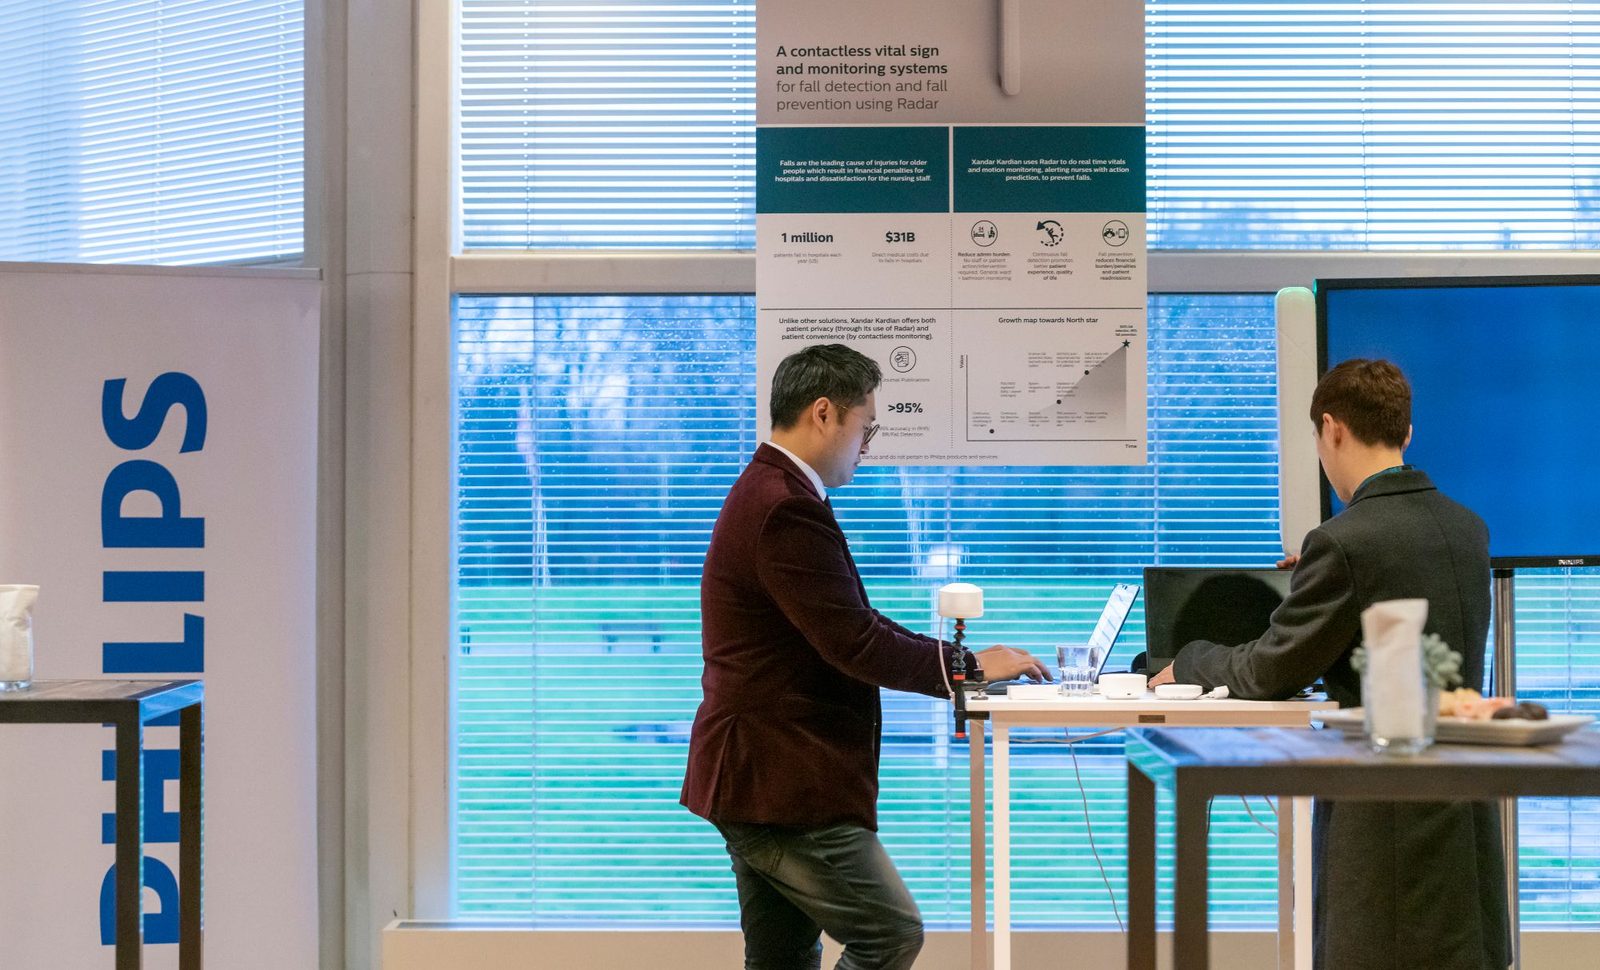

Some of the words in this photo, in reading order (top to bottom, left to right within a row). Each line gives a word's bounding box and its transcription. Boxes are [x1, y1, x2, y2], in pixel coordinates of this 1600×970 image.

[776, 45, 787, 57] A
[790, 45, 871, 57] contactless
[875, 44, 906, 57] vital
[910, 44, 939, 59] sign
[776, 63, 803, 75] and
[808, 62, 886, 77] monitoring
[890, 63, 948, 77] systems
[776, 80, 796, 93] for
[799, 80, 820, 93] fall
[824, 80, 891, 93] detection
[895, 80, 922, 92] and
[926, 79, 947, 92] fall
[777, 98, 851, 112] prevention
[856, 98, 893, 112] using
[897, 97, 939, 110] Radar
[779, 159, 796, 167] Falls
[820, 159, 845, 167] leading
[782, 167, 806, 175] people
[883, 167, 914, 175] penalties
[1044, 166, 1070, 174] alerting
[774, 175, 805, 183] hospitals
[890, 175, 915, 183] nursing
[781, 232, 787, 243] 1
[791, 232, 833, 243] million
[886, 231, 915, 243] $31B
[835, 325, 863, 333] (through
[893, 325, 916, 333] Radar)
[781, 333, 805, 341] patient
[846, 333, 857, 341] (by
[895, 333, 933, 341] monitoring).
[888, 402, 923, 413] >95%
[99, 371, 207, 945] PHLIPS
